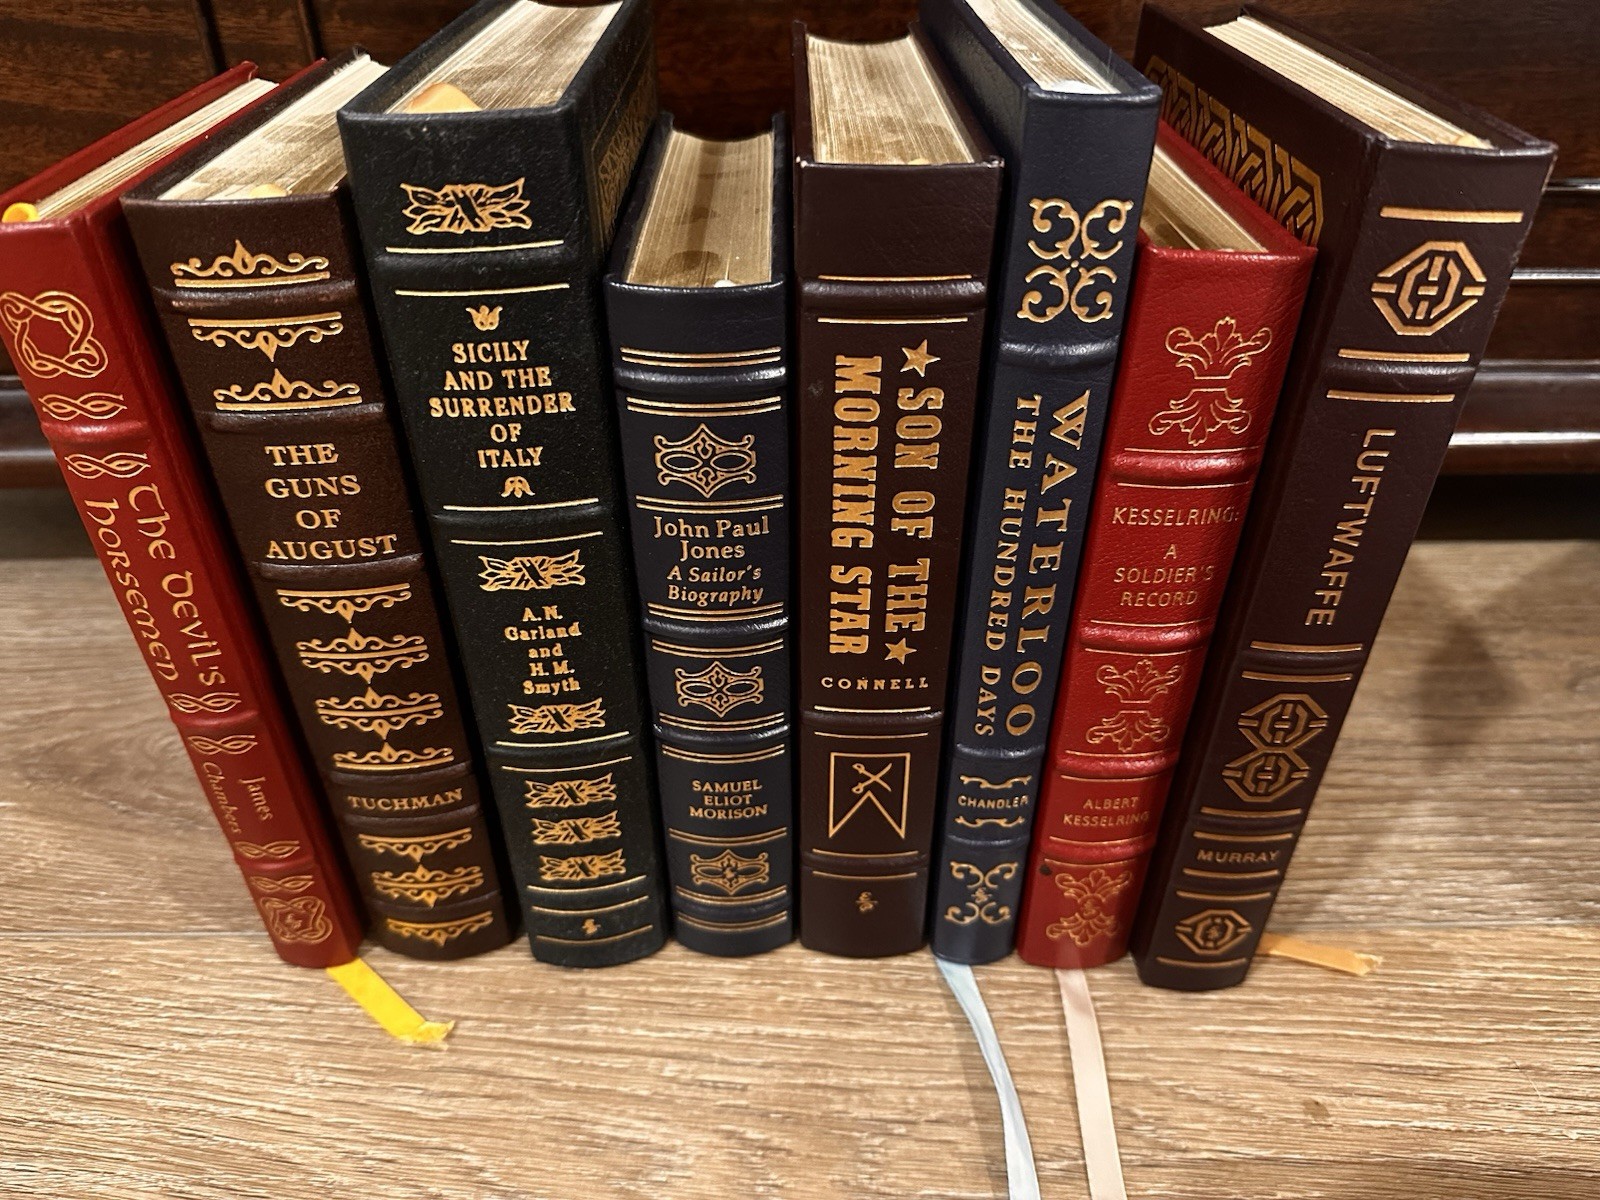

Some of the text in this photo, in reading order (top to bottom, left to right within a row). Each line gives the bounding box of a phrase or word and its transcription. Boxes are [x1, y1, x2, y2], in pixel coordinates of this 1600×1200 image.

[452, 339, 530, 363] SICILY
[443, 366, 552, 391] AND THE
[429, 391, 576, 417] SURRENDER
[490, 422, 522, 442] OF
[264, 442, 339, 467] THE
[477, 446, 543, 468] ITALY
[264, 474, 362, 499] GUNS
[828, 354, 883, 655] MORNING STAR
[884, 386, 945, 633] SON OF THE
[128, 482, 176, 560] The
[295, 508, 342, 530] OF
[653, 515, 770, 539] John Paul
[1304, 427, 1397, 627] LUFTWAFFE
[266, 533, 398, 560] AUGUST
[680, 540, 746, 562] Jones
[1163, 543, 1178, 560] A
[667, 565, 762, 582] A Sailor's
[974, 393, 1043, 737] THE HUNDRED DAYS
[1005, 389, 1091, 737] WATERLOO
[1113, 565, 1215, 584] SOLDIER'S
[668, 585, 764, 607] Biography
[1120, 590, 1199, 607] RECORD
[504, 622, 582, 641] Garland
[528, 643, 563, 658] and
[522, 677, 581, 695] Smyth
[820, 676, 930, 691] CONNELL
[692, 779, 763, 793] SAMUEL
[203, 761, 242, 834] Chambers
[238, 775, 274, 821] James
[347, 788, 463, 811] TUCHMAN
[703, 793, 753, 807] ELIOT
[957, 795, 1029, 809] CHANDLER
[1082, 796, 1139, 810] ALBERT
[689, 803, 768, 819] MORISON
[1063, 811, 1150, 827] KESSELRING
[1196, 849, 1280, 863] MURRAY
